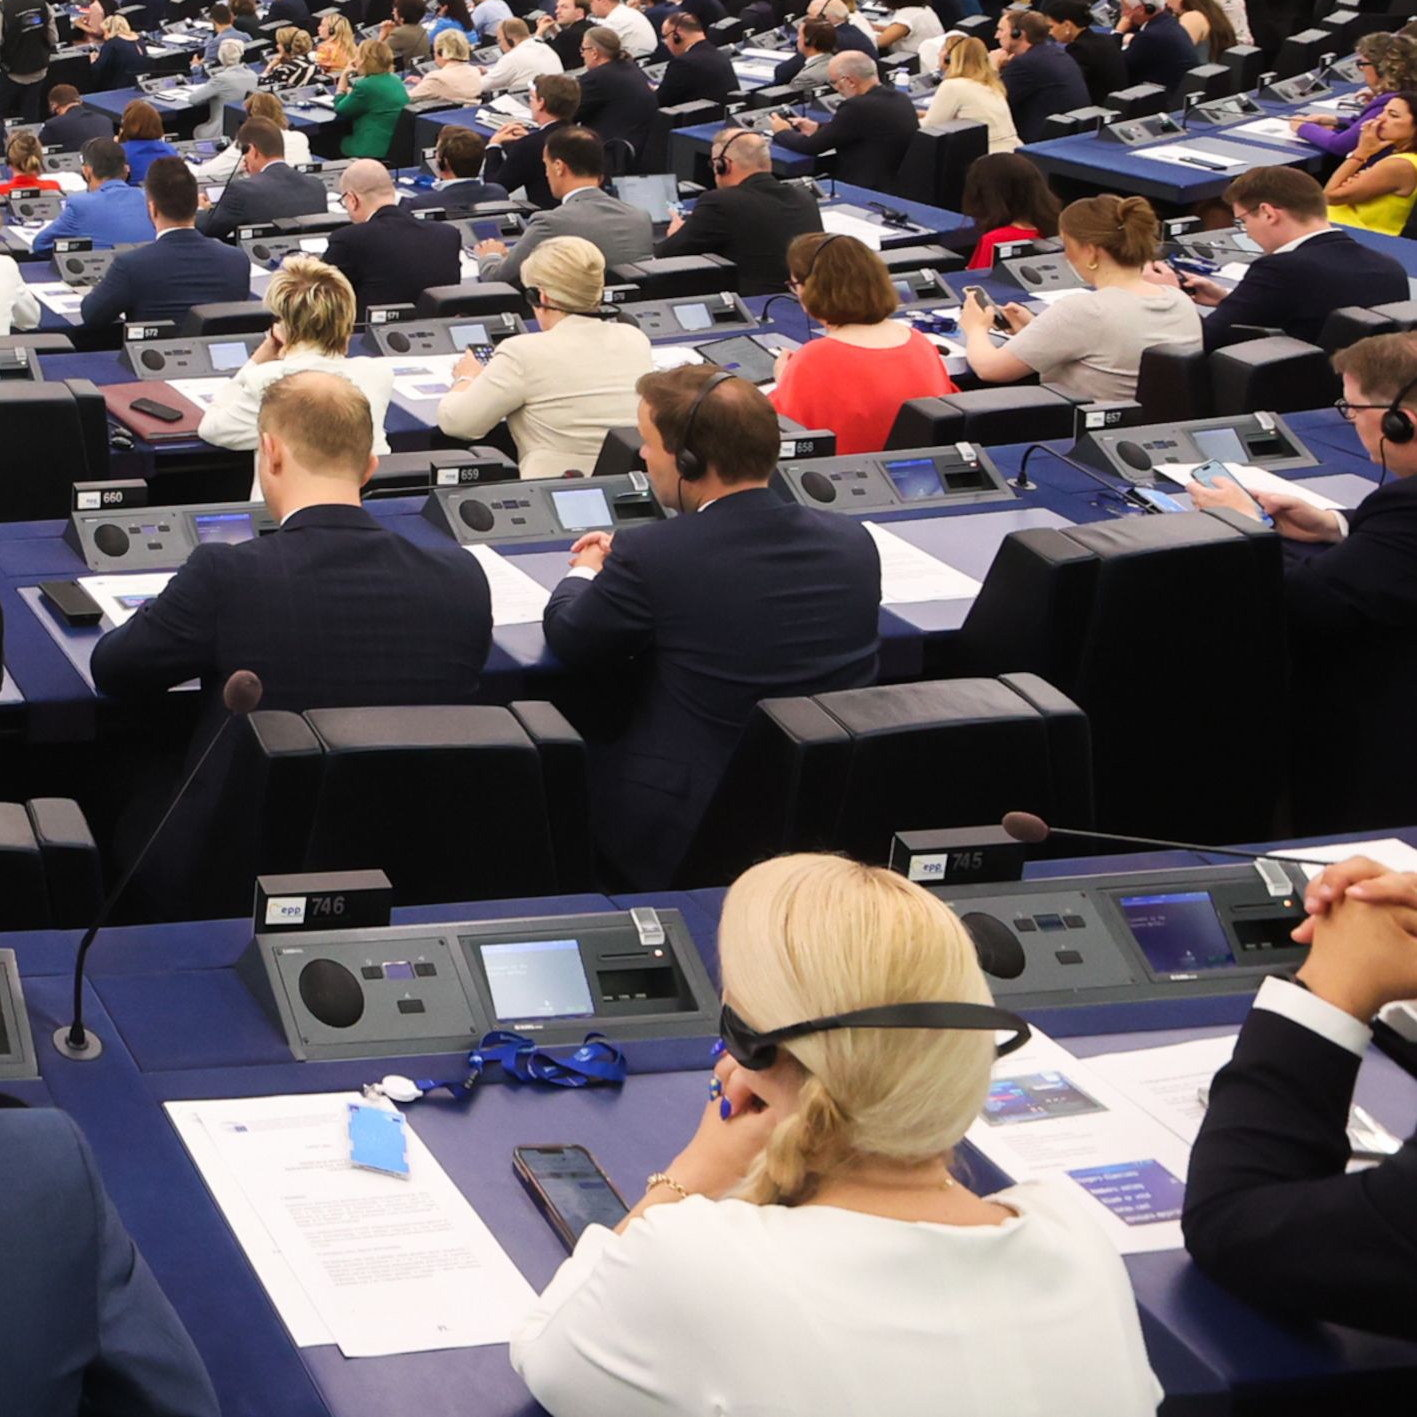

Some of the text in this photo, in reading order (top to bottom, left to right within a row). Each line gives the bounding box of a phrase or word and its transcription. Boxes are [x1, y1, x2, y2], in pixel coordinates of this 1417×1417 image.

[145, 328, 159, 337] 572
[1106, 412, 1121, 424] 657
[460, 469, 479, 481] 659
[103, 491, 123, 503] 660
[952, 852, 983, 871] 745
[923, 862, 943, 874] epp
[281, 904, 301, 916] epp
[312, 897, 345, 916] 746
